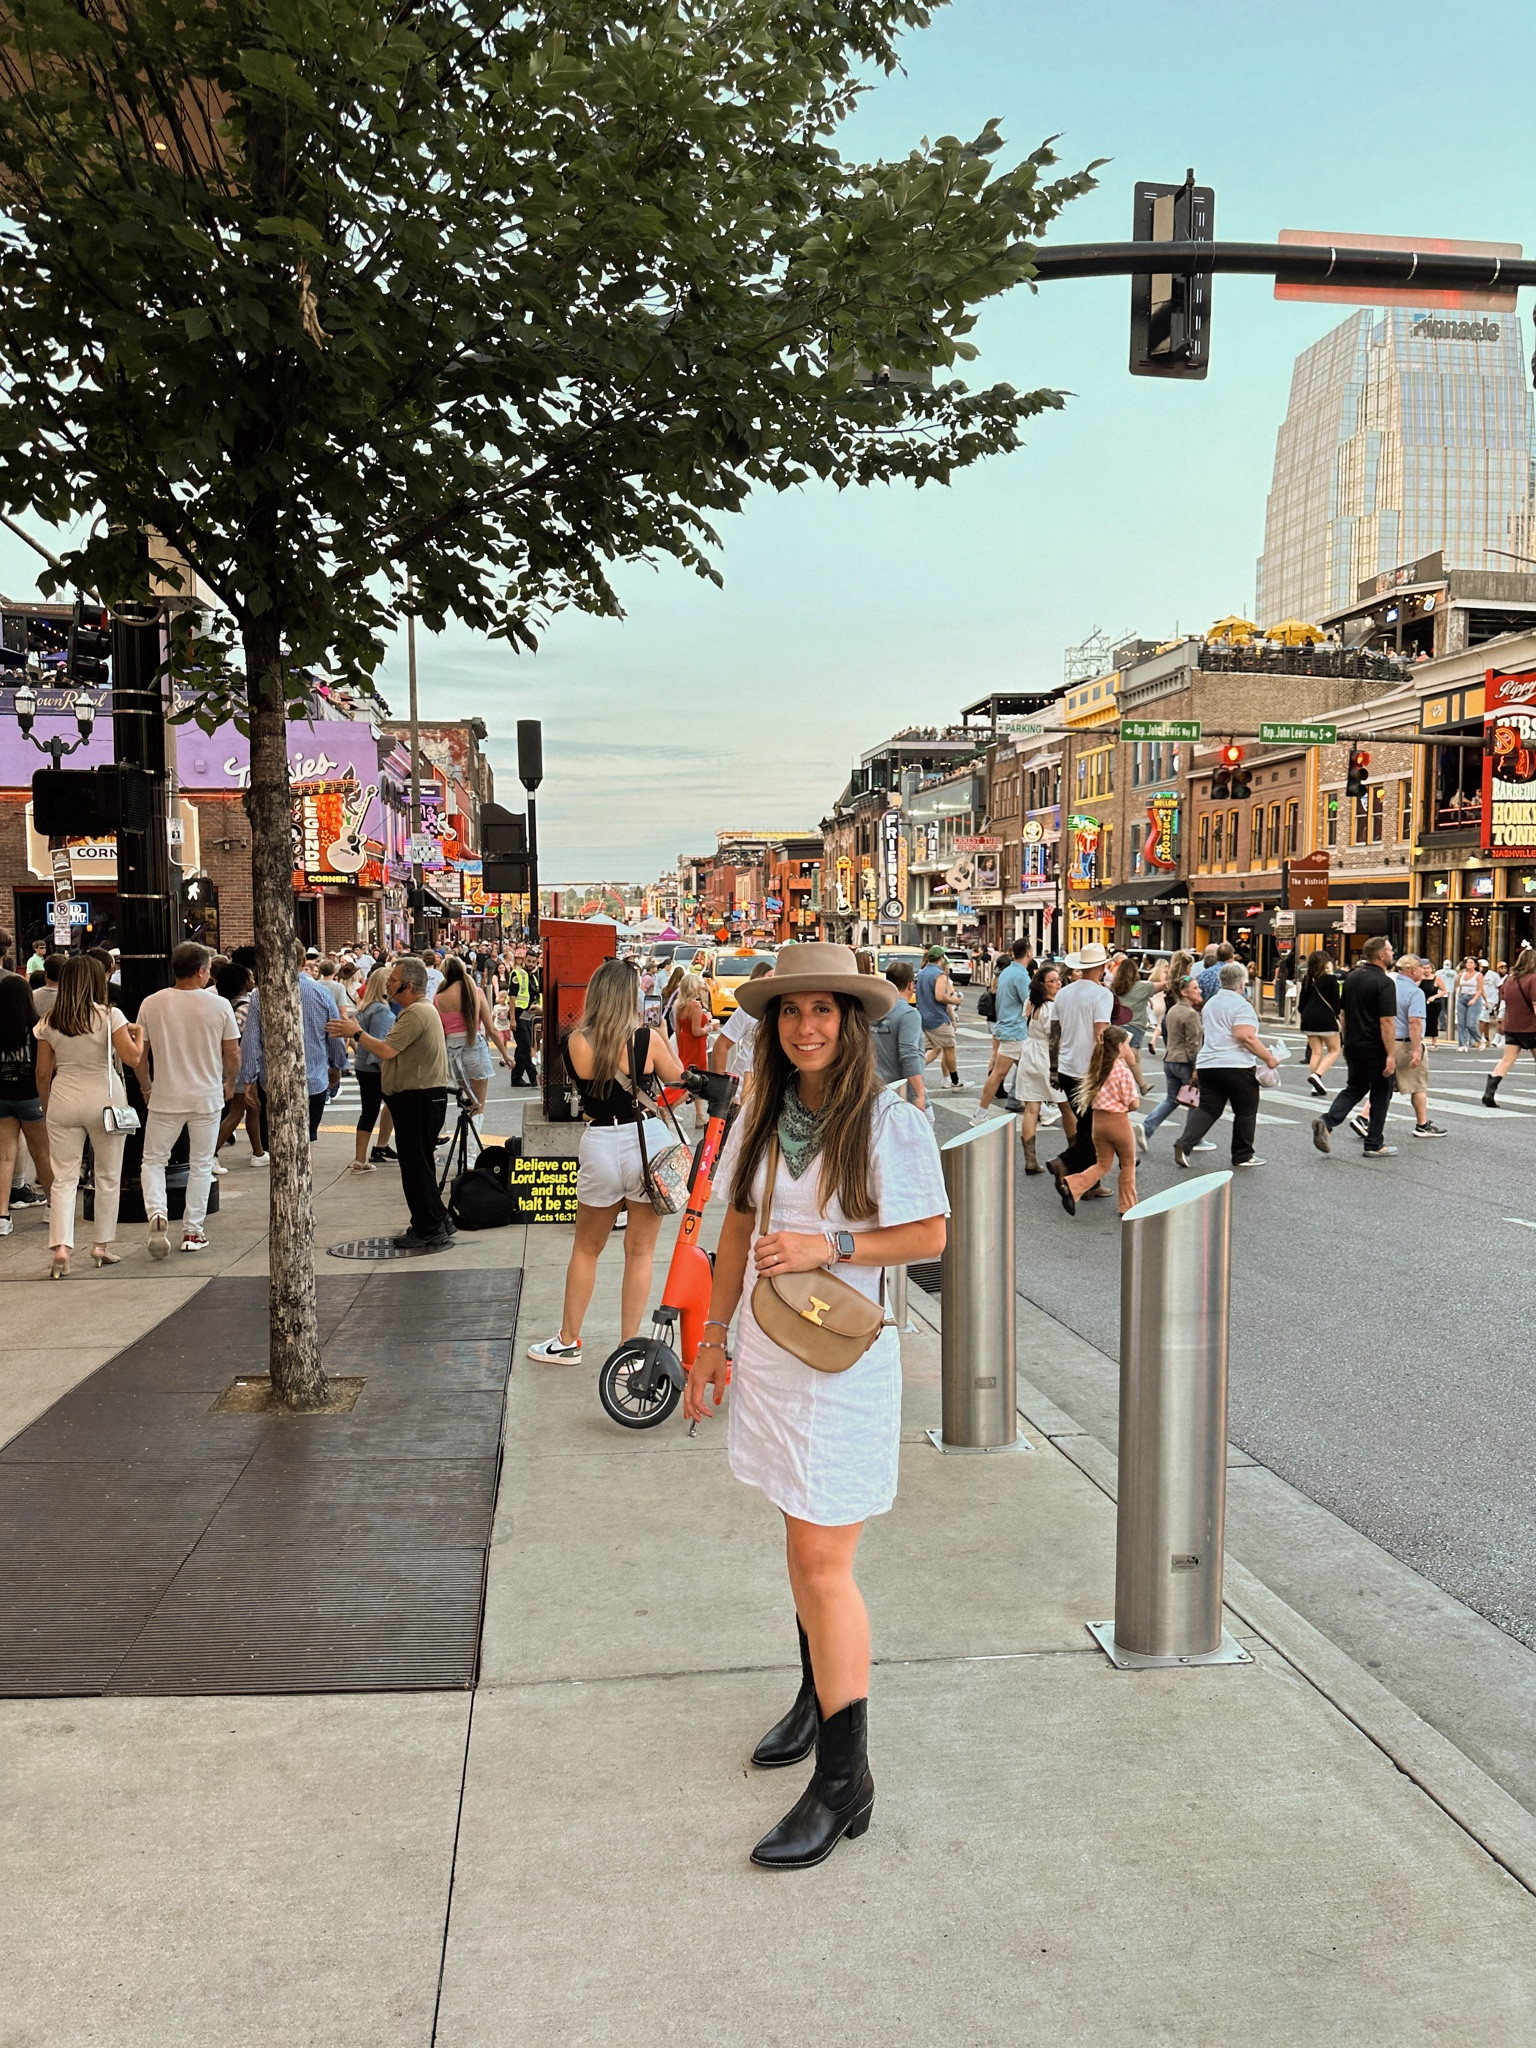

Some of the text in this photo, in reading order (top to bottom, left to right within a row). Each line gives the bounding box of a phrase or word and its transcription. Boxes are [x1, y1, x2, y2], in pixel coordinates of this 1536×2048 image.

[1412, 313, 1500, 341] Pinnacle
[1005, 724, 1042, 733] PARKING
[1147, 724, 1161, 736] John
[1162, 724, 1180, 737] Lewis
[1192, 726, 1197, 737] N
[1276, 726, 1290, 738] John
[1291, 727, 1308, 739] Lewis
[1319, 728, 1324, 740] S
[304, 796, 320, 872] LEGENDS
[1162, 809, 1171, 860] MUSHROOM
[77, 848, 117, 858] CORN
[886, 815, 898, 898] FRIENDS
[308, 875, 348, 883] CORNER
[515, 1158, 577, 1171] Believe on
[511, 1171, 578, 1184] Lord Jesus C
[531, 1184, 553, 1196] and
[546, 1197, 562, 1211] be
[564, 1200, 578, 1211] sa
[534, 1213, 577, 1222] Acts 16:31
